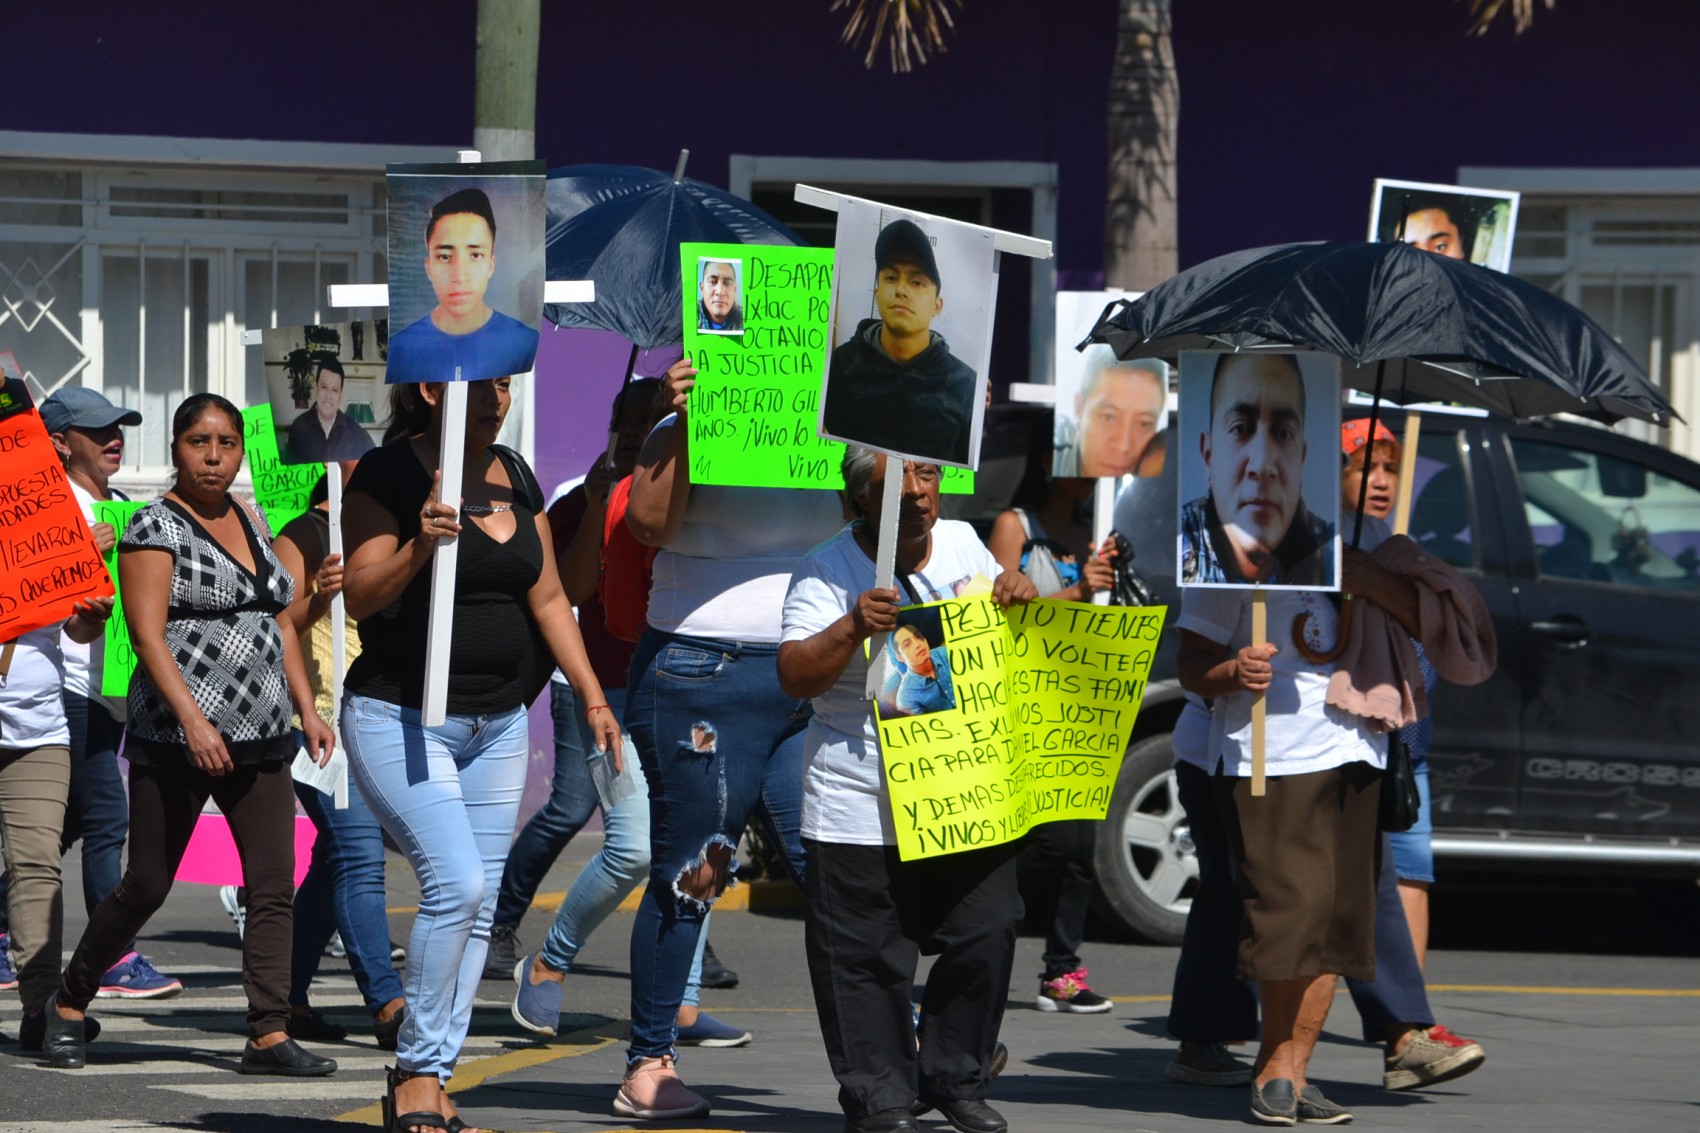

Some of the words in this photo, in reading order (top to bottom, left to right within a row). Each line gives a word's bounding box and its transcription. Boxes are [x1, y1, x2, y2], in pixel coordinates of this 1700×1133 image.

[748, 257, 834, 291] DESAPA
[689, 385, 784, 419] HUMBERTO
[0, 465, 64, 504] PUESTA
[1022, 601, 1056, 627] TU
[1064, 607, 1160, 642] TIENES
[949, 646, 985, 676] UN
[1042, 638, 1152, 674] VOLTEA
[1087, 677, 1145, 704] FAMI
[1046, 702, 1122, 730] JUSTI
[888, 756, 936, 784] CIA
[934, 743, 1001, 773] PARA
[1042, 728, 1120, 754] GARCIA
[902, 801, 918, 831] Y
[922, 783, 1005, 821] DEMAS
